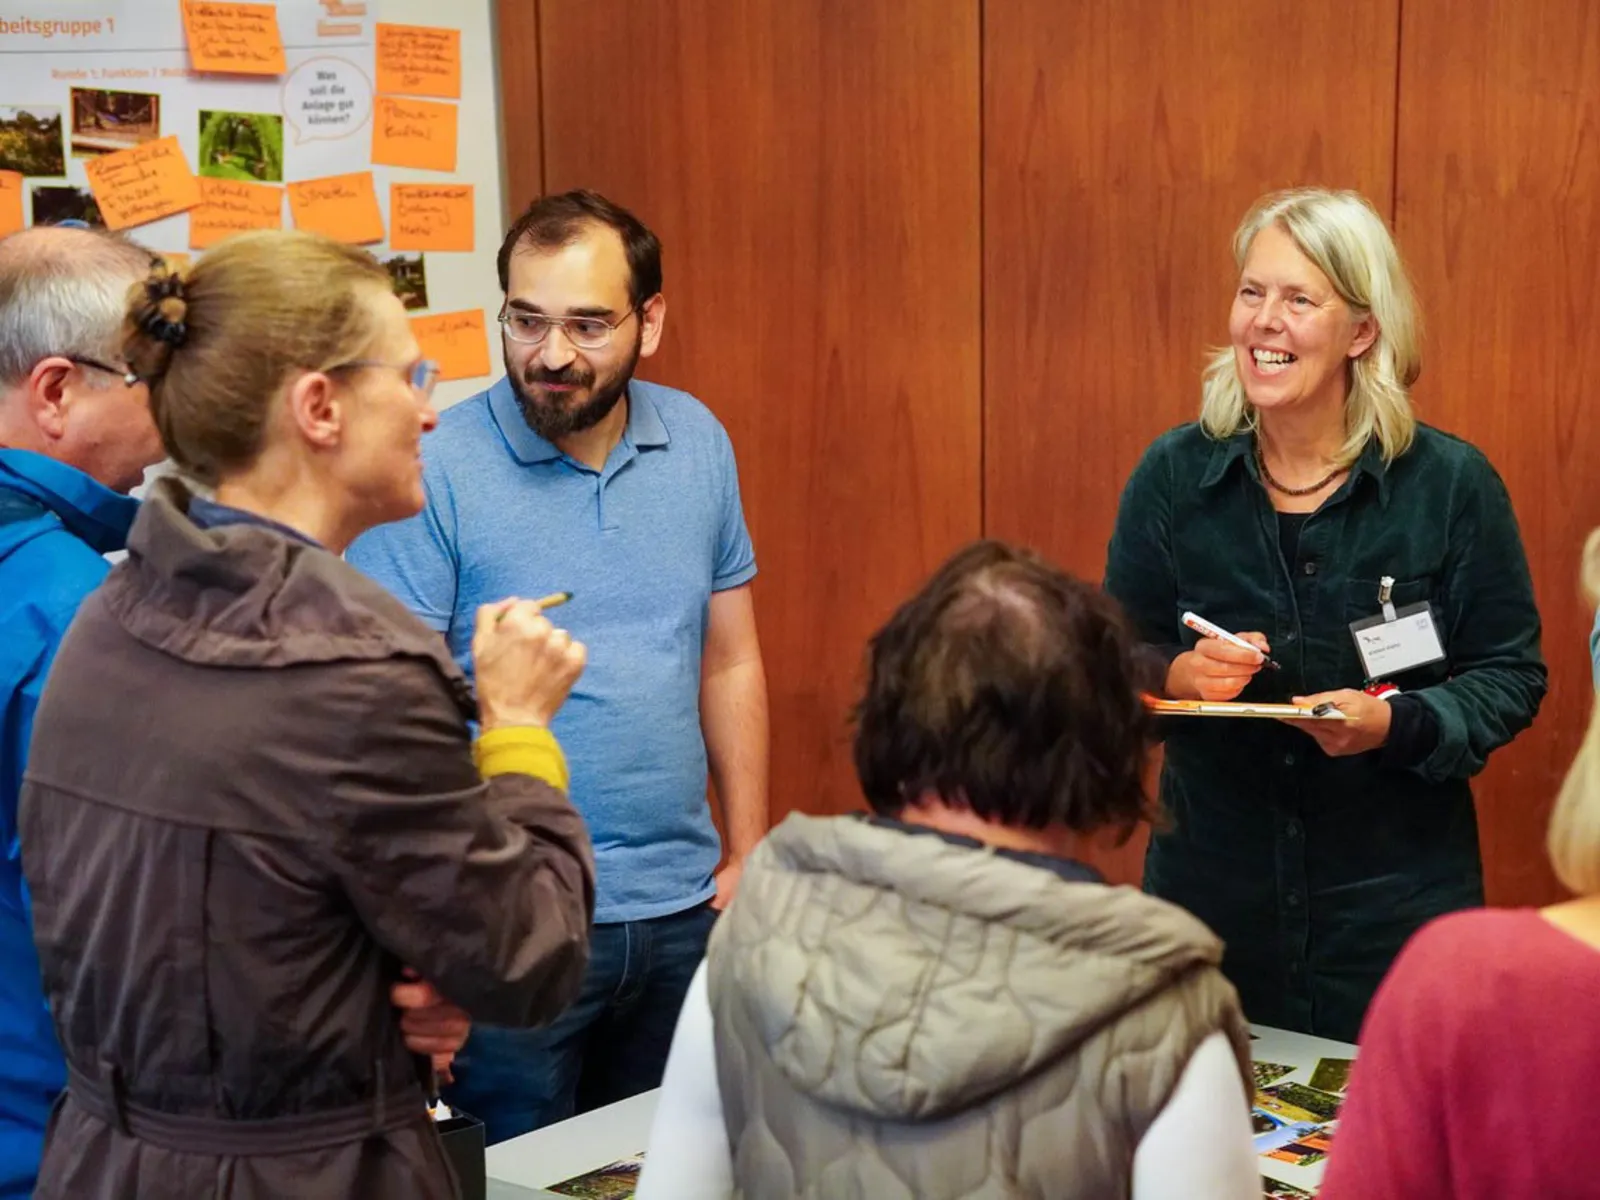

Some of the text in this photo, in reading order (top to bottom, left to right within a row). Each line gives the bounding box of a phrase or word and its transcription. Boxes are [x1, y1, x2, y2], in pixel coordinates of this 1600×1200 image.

[107, 18, 115, 34] 1
[102, 66, 150, 78] Funktion
[330, 85, 346, 95] die
[302, 101, 336, 112] Anlage
